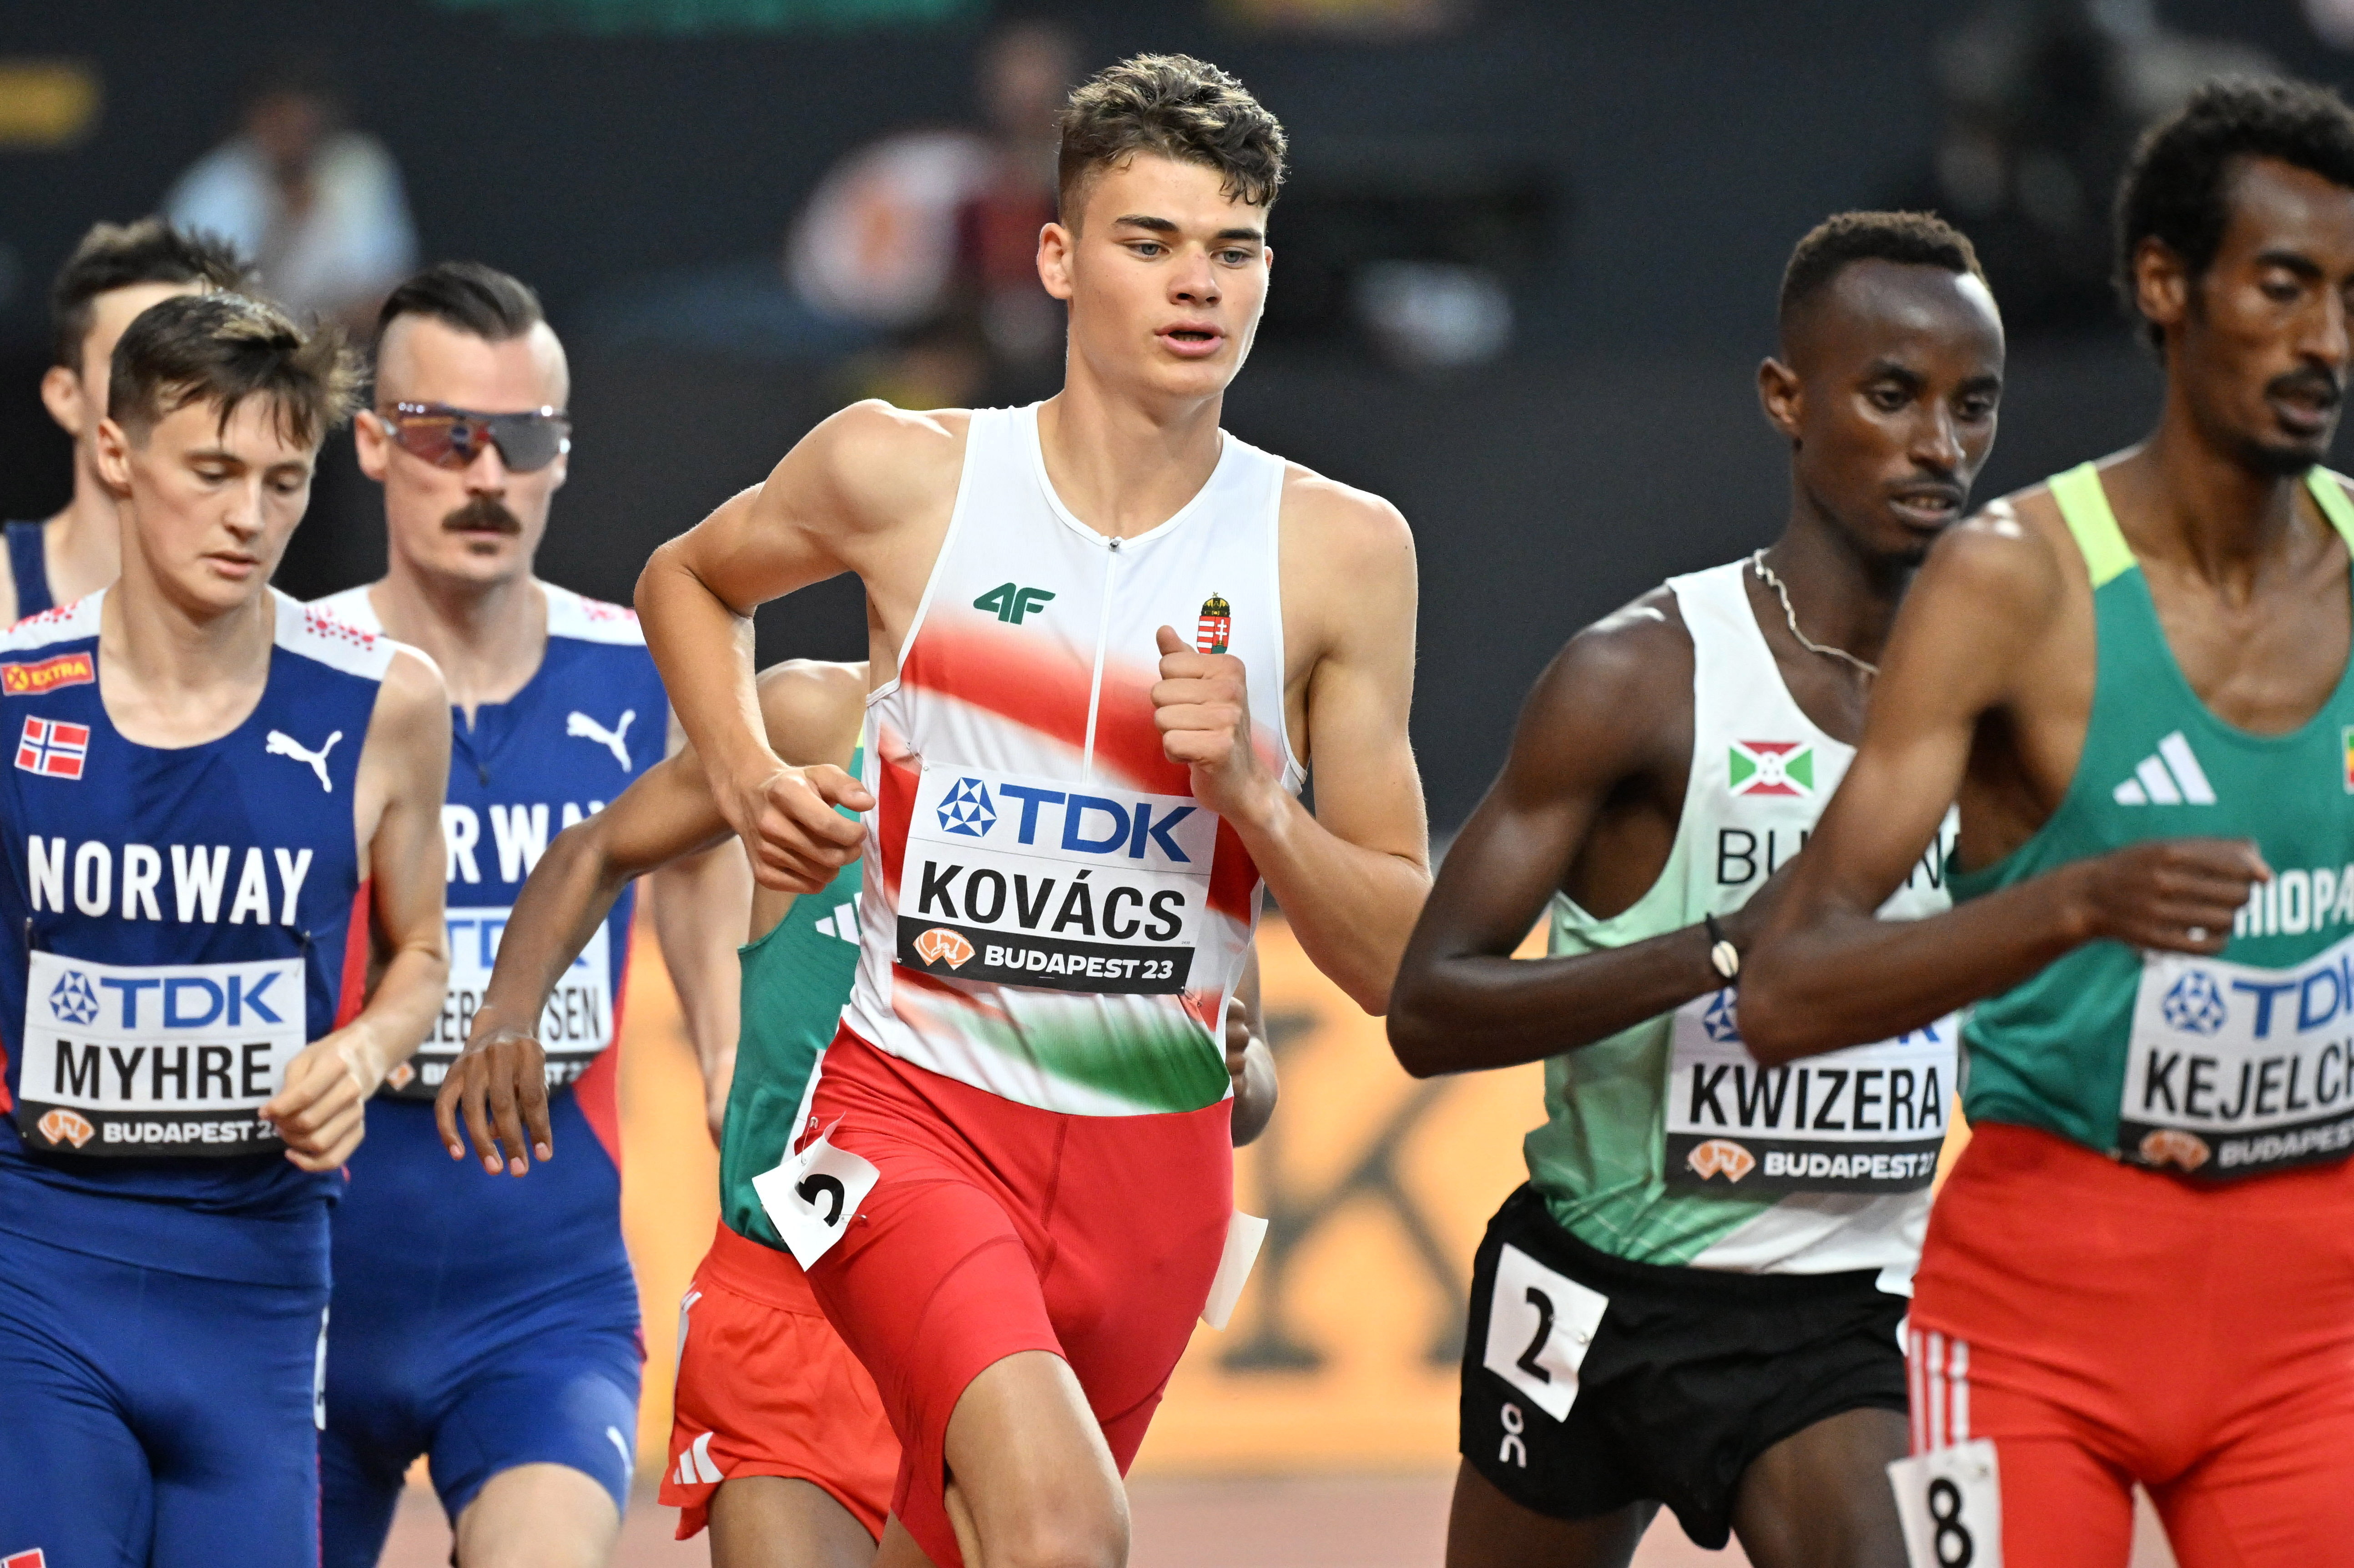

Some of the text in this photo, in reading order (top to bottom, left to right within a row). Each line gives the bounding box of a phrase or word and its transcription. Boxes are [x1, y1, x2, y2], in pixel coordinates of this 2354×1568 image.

[973, 582, 1056, 625] 4F
[31, 661, 88, 686] EXTRA
[999, 783, 1197, 863] TDK
[27, 834, 314, 927] NORWAY
[918, 860, 1185, 942] KOVÁCS
[984, 944, 1174, 979] BUDAPEST 23
[101, 972, 284, 1029] TDK
[55, 1039, 272, 1100] MYHRE
[1689, 1062, 1941, 1131] KWIZERA
[103, 1119, 279, 1143] BUDAPEST 2
[1764, 1152, 1919, 1179] BUDAPEST
[1516, 1286, 1554, 1384] 2
[1927, 1477, 1974, 1568] 8
